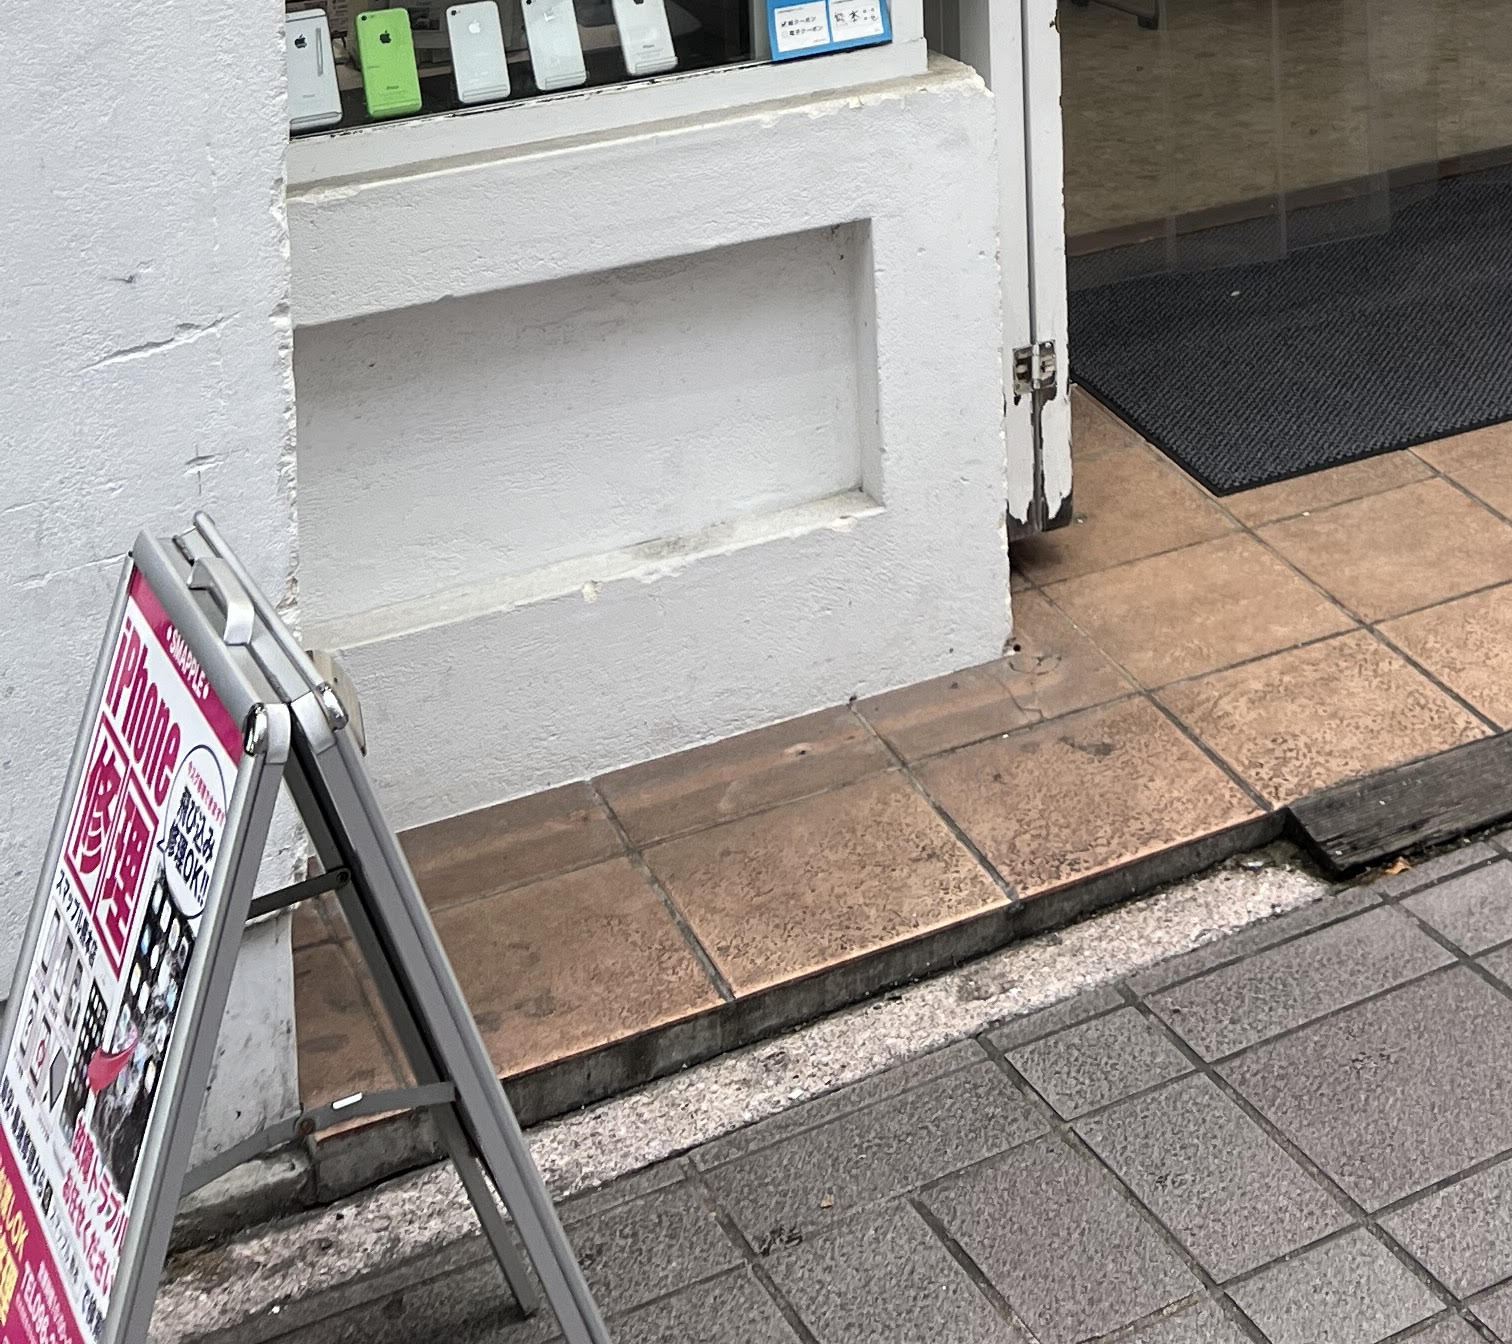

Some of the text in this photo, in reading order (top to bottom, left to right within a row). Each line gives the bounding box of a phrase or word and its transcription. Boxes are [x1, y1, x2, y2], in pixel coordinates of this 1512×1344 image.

[106, 619, 181, 807] iPhone
[169, 628, 206, 700] SMAPPLE
[71, 734, 150, 939] 修理
